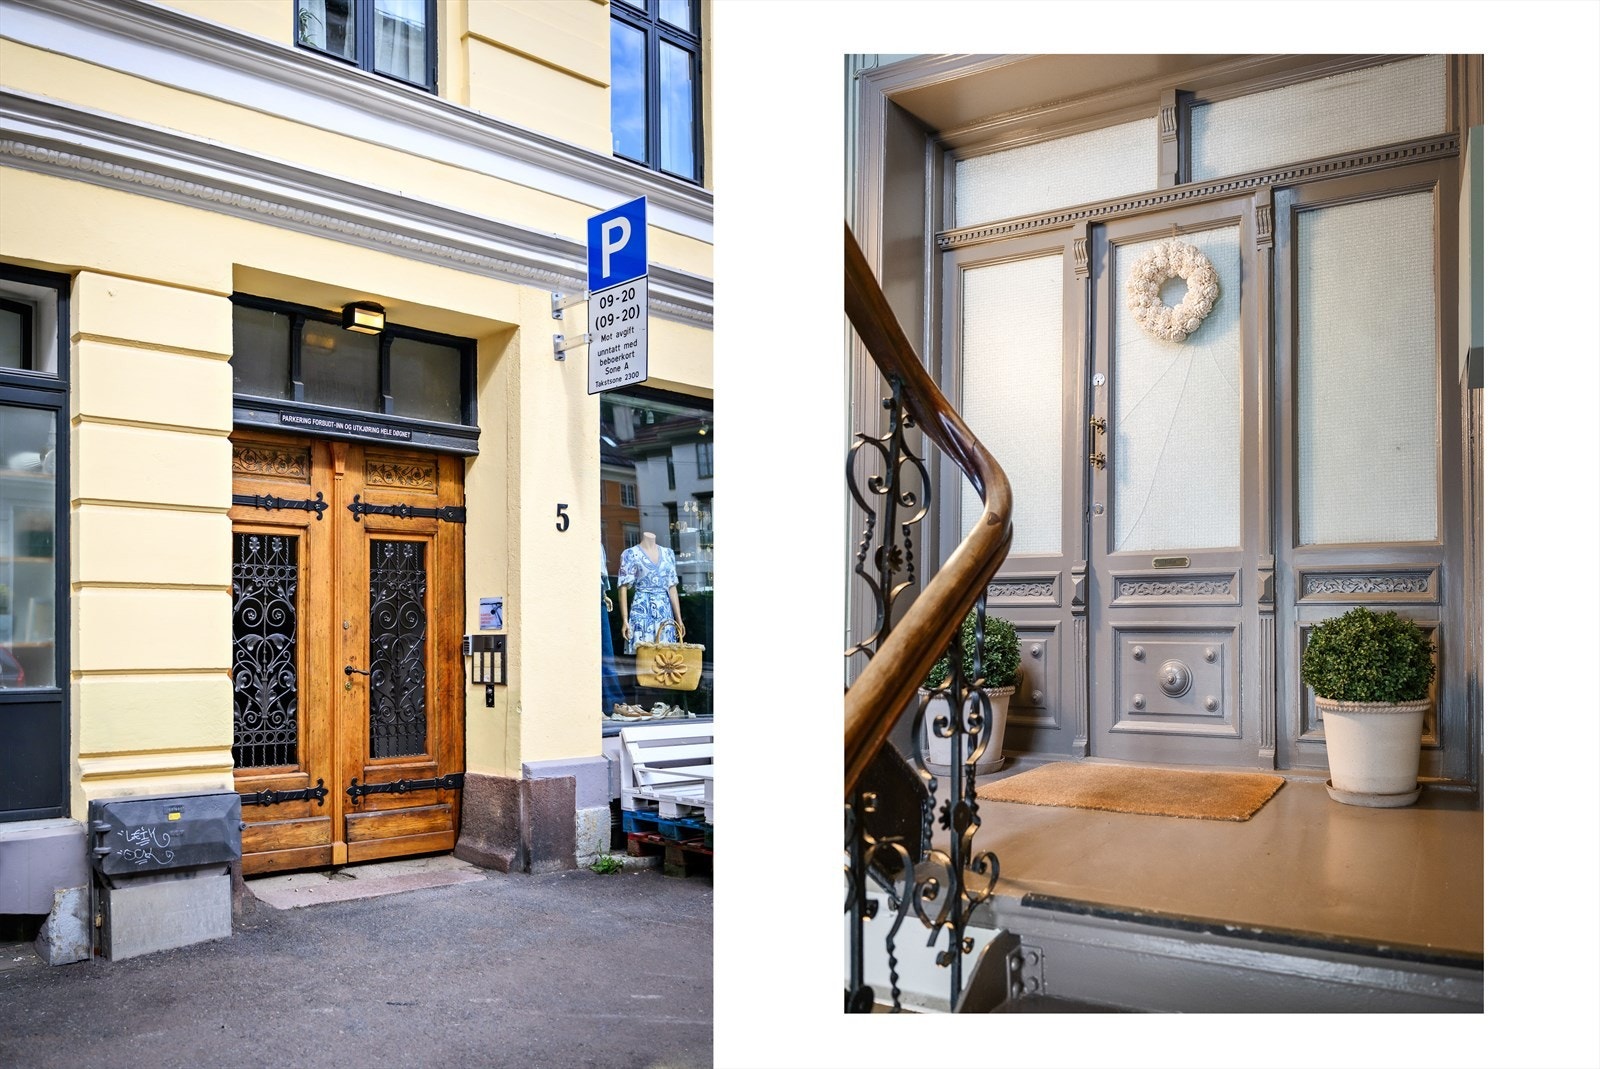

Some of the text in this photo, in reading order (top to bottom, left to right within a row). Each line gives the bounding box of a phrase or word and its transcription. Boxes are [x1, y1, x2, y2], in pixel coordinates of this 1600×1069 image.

[601, 216, 632, 279] P
[600, 287, 635, 309] 09-20
[600, 326, 635, 343] Mot avgift
[597, 339, 638, 357] unntatt med
[599, 351, 635, 367] beboerkort
[605, 361, 629, 375] Sone A
[595, 370, 640, 388] Takstsone 2300
[282, 414, 312, 425] PARKERING
[344, 423, 352, 431] OG
[352, 424, 380, 434] UTKJØRING
[380, 427, 393, 436] HELE
[393, 430, 410, 438] DØGNET
[556, 503, 570, 533] 5
